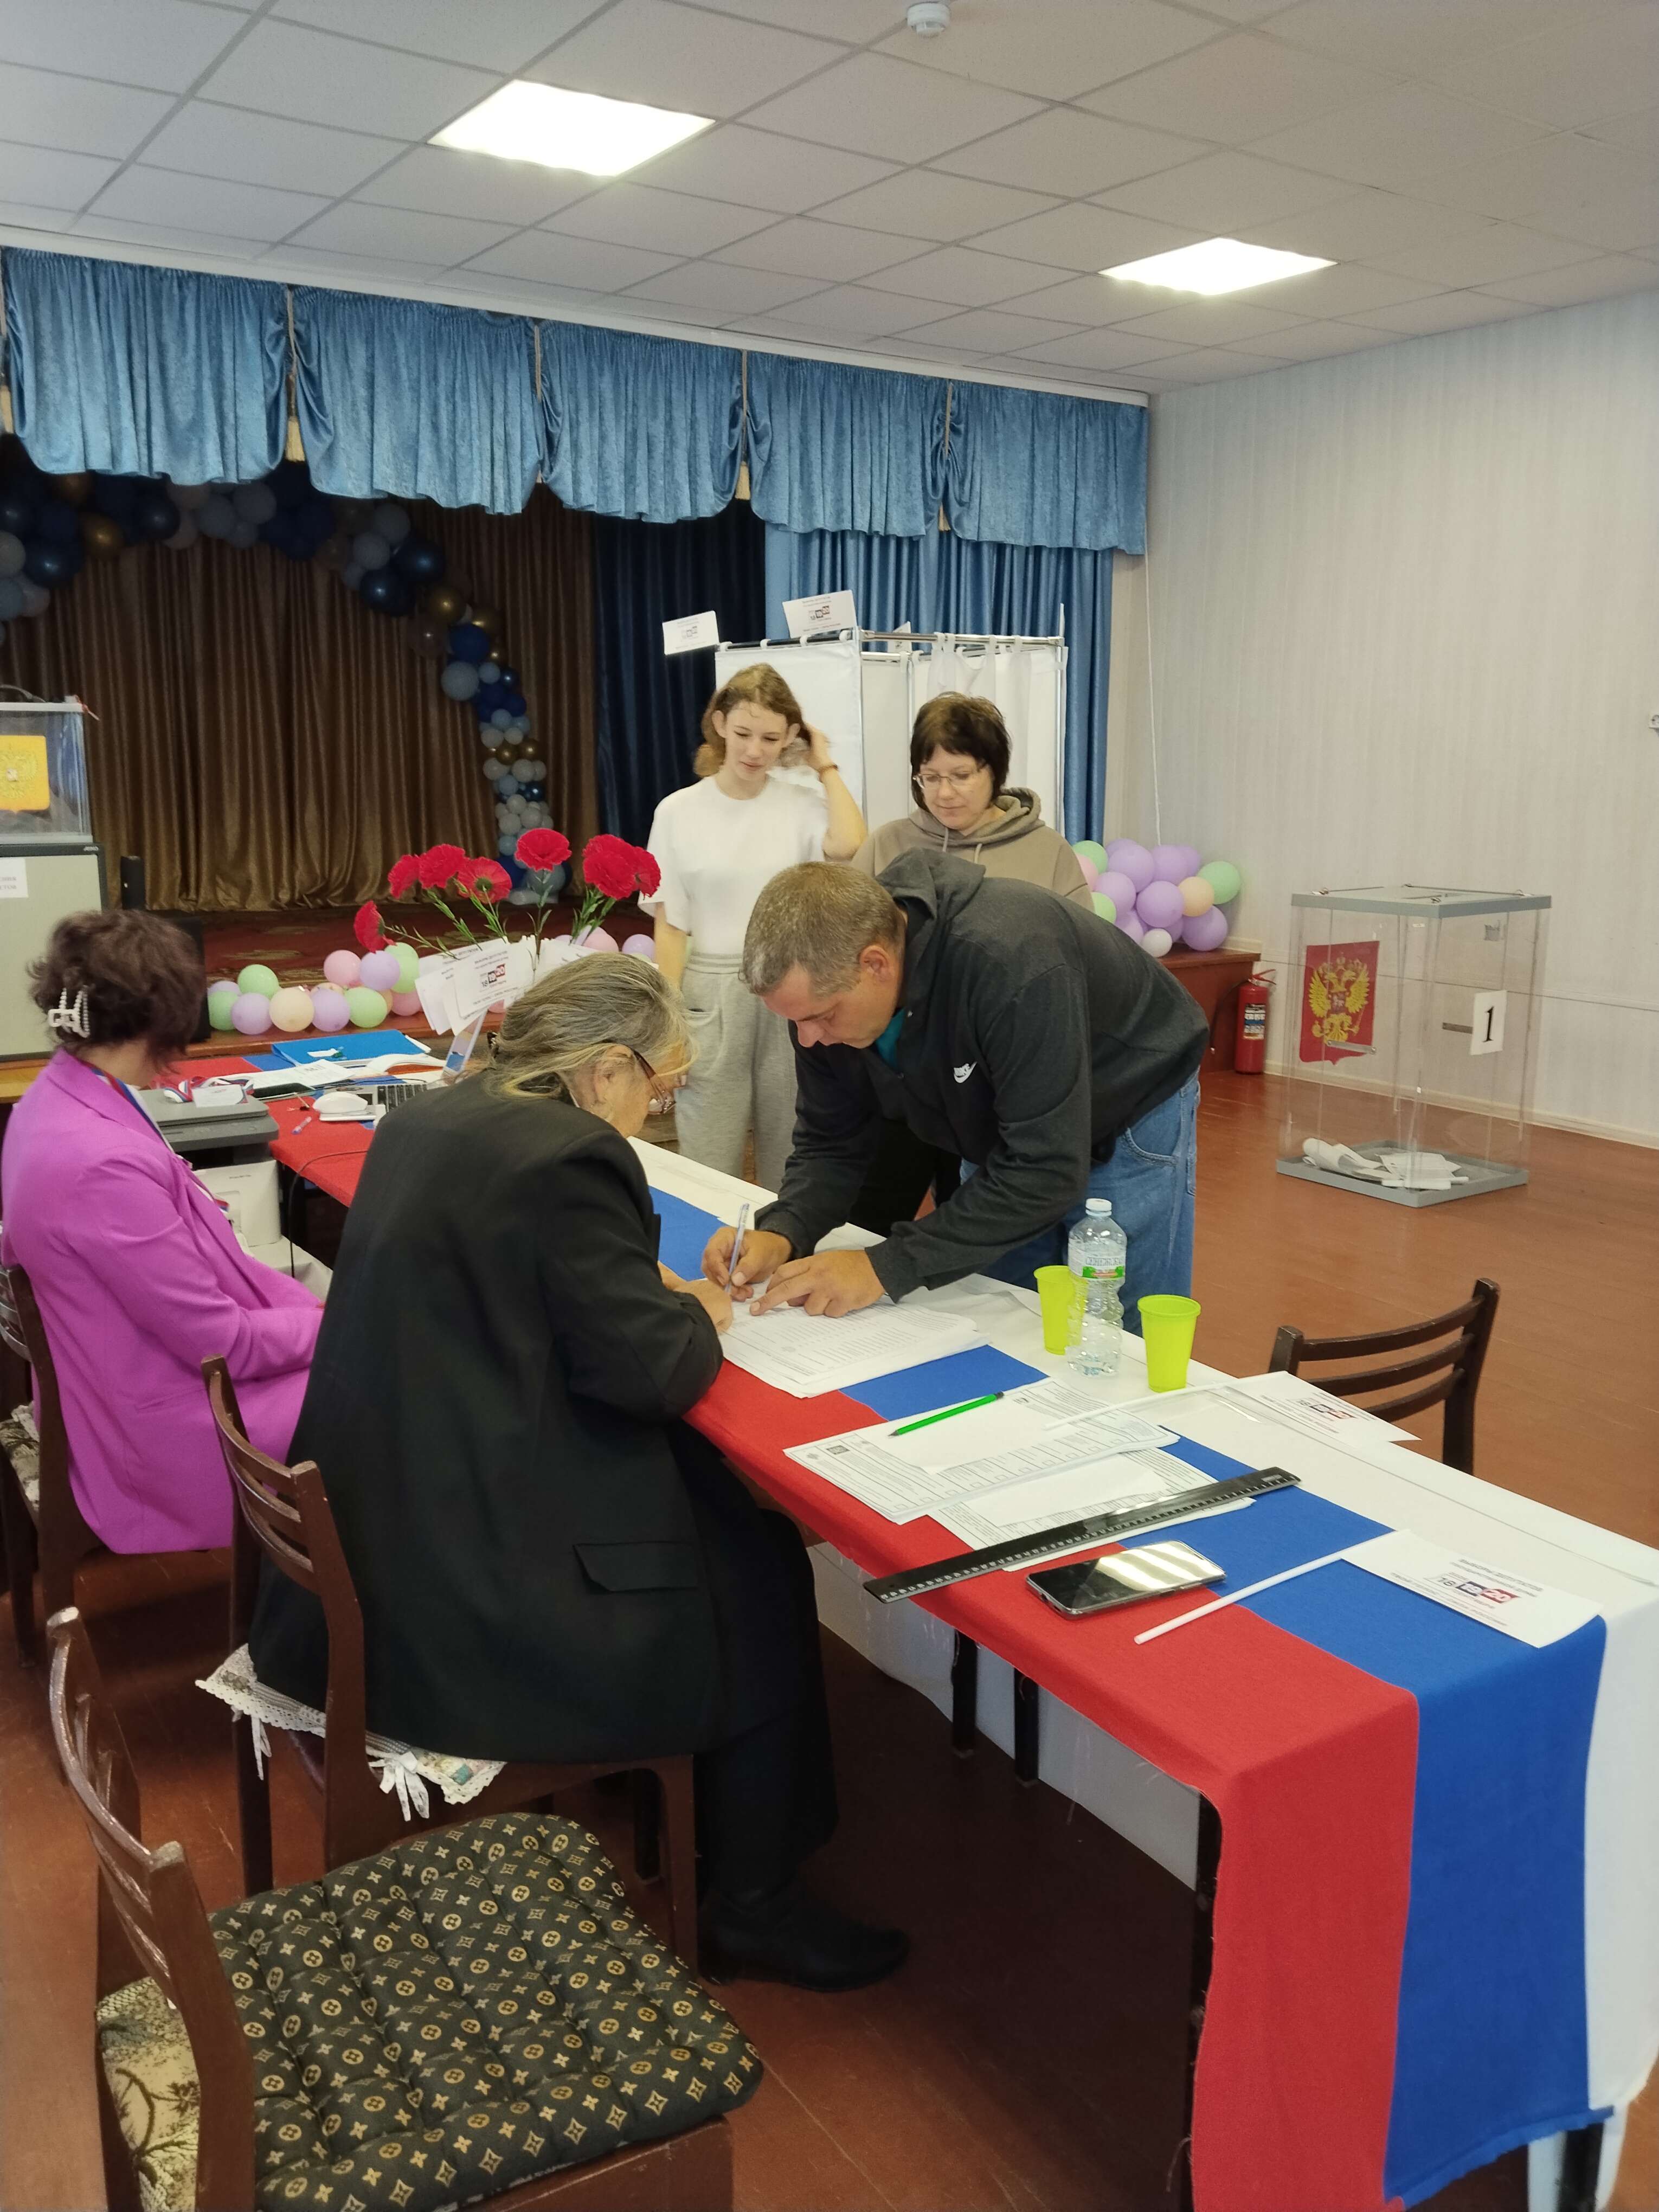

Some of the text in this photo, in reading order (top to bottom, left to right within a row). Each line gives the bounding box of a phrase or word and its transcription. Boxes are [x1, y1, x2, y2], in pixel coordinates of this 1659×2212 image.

[1482, 1006, 1495, 1043] 1
[1437, 1577, 1512, 1602] 18 19 20
